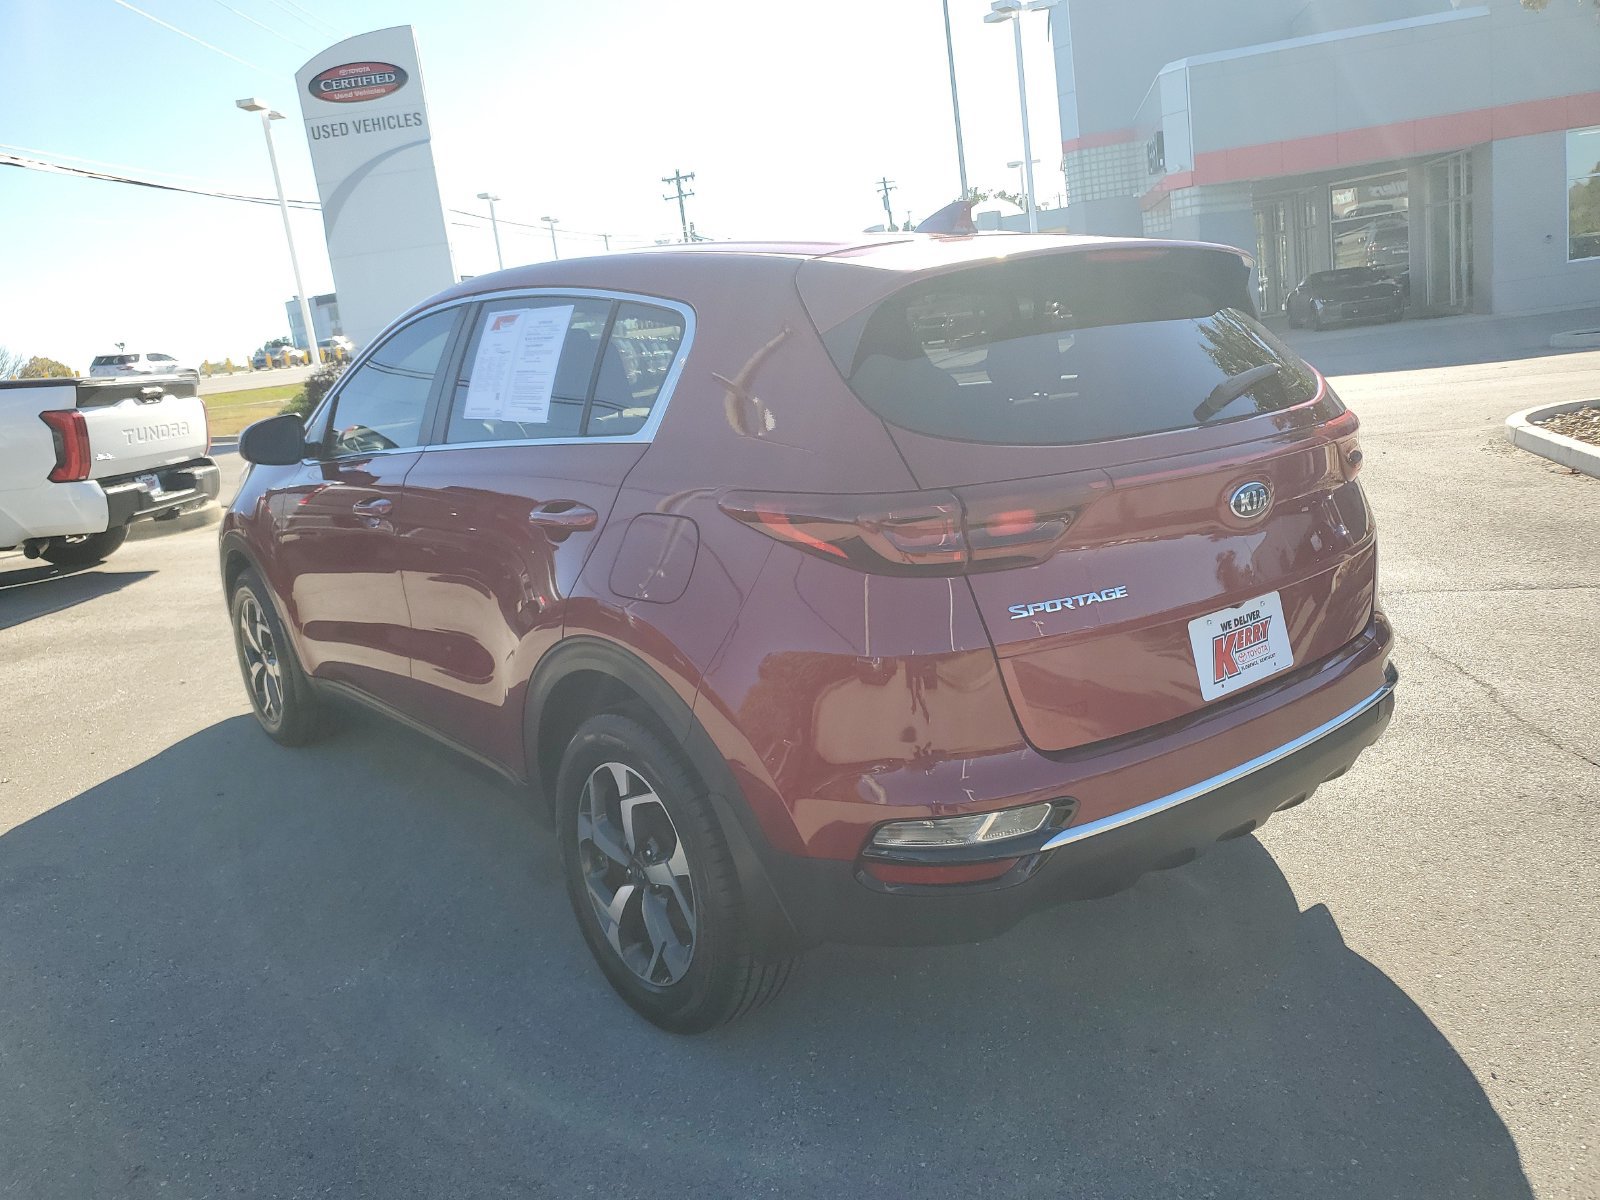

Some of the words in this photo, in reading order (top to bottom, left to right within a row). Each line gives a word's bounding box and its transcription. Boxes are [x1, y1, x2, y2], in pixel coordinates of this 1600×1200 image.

[348, 66, 370, 74] TOYOTA
[334, 91, 353, 99] Used
[354, 88, 386, 97] Vehicles
[311, 122, 349, 140] USED
[352, 112, 423, 134] VEHICLES
[121, 421, 190, 446] TUNDRA
[1239, 488, 1267, 512] KIA
[1008, 585, 1129, 619] SPORTAGE
[1220, 621, 1233, 632] WE
[1233, 610, 1261, 627] DELIVER
[1212, 615, 1272, 685] KERRY
[1247, 644, 1268, 659] TOYOTA
